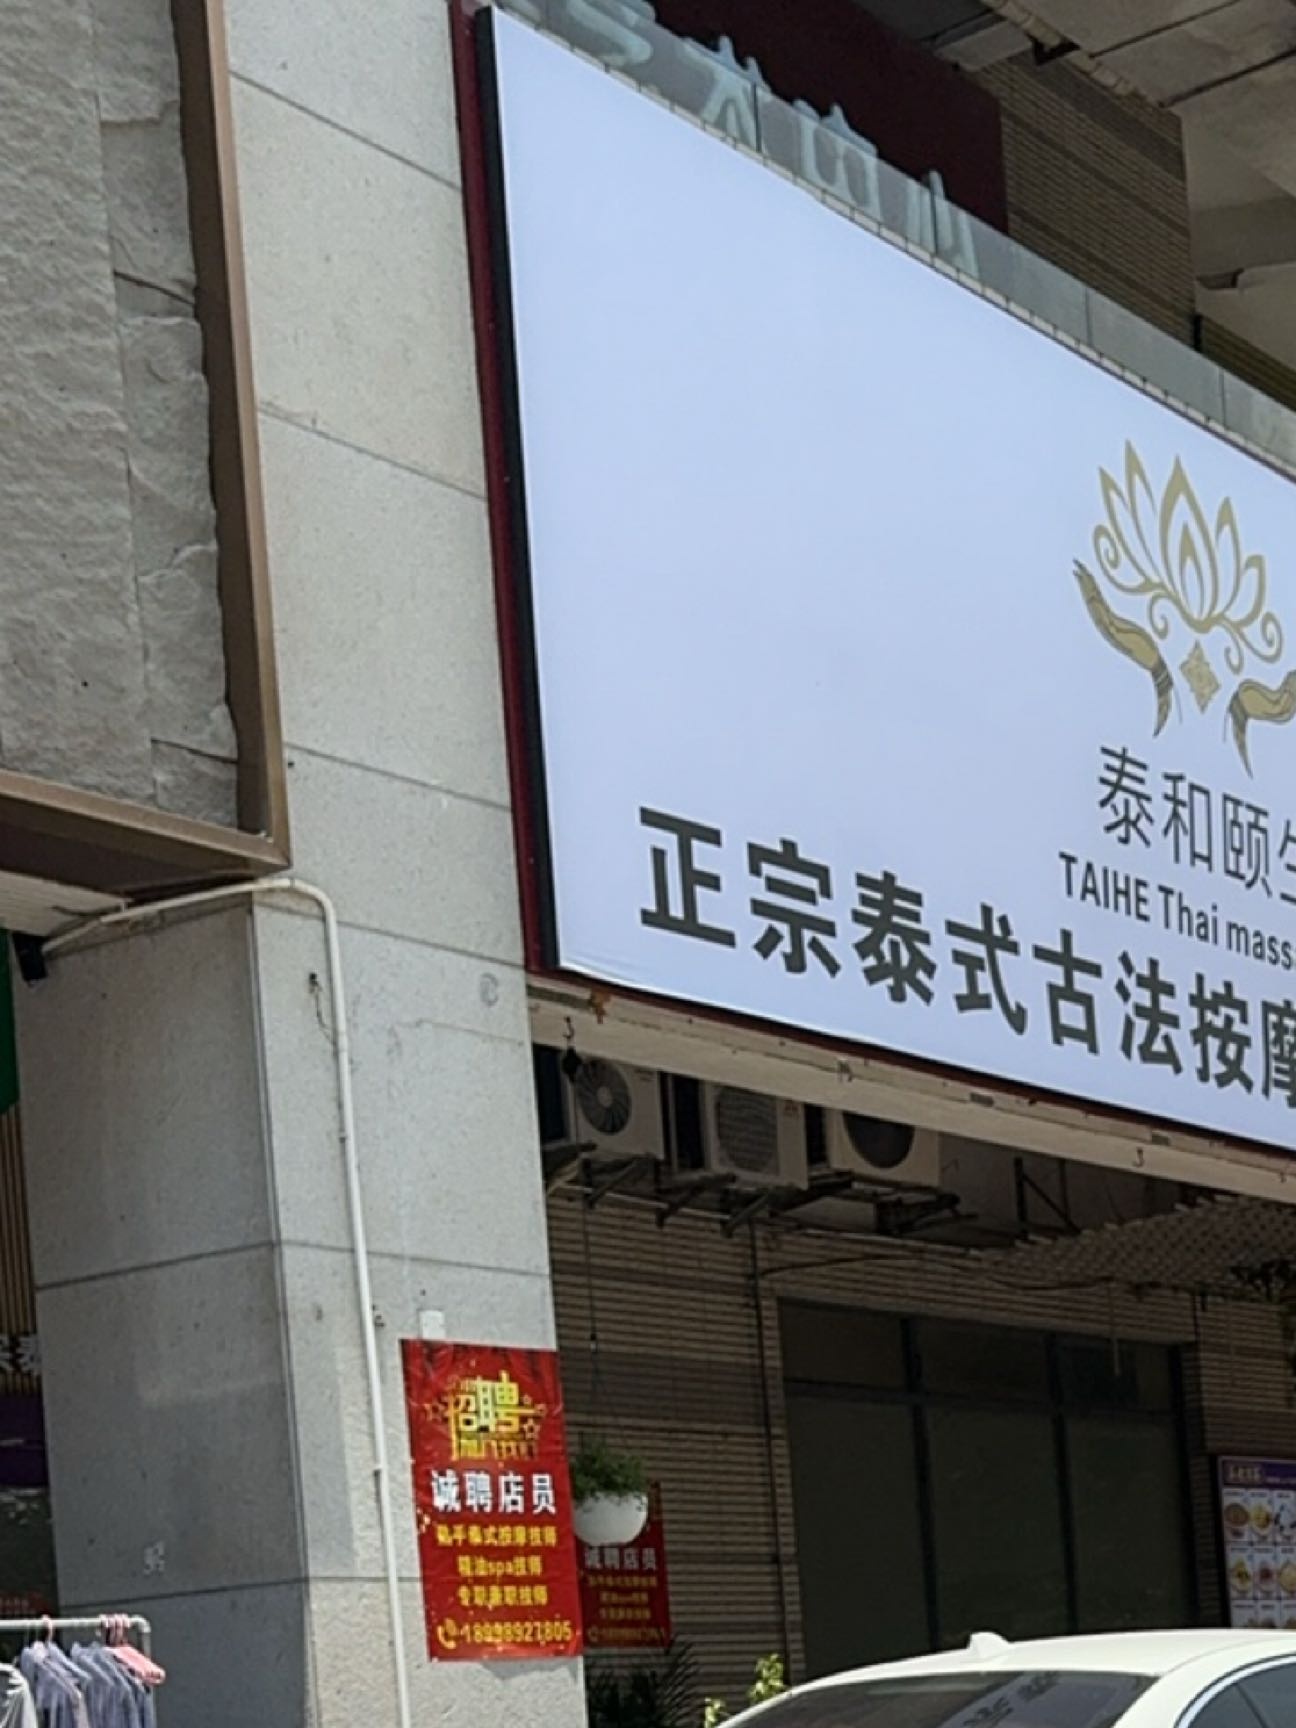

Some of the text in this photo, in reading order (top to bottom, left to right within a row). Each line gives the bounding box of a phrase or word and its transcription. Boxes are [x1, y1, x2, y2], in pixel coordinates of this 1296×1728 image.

[1058, 851, 1151, 923] TAIHE
[1157, 884, 1219, 945] Thai
[431, 1468, 557, 1515] 诚聘店员
